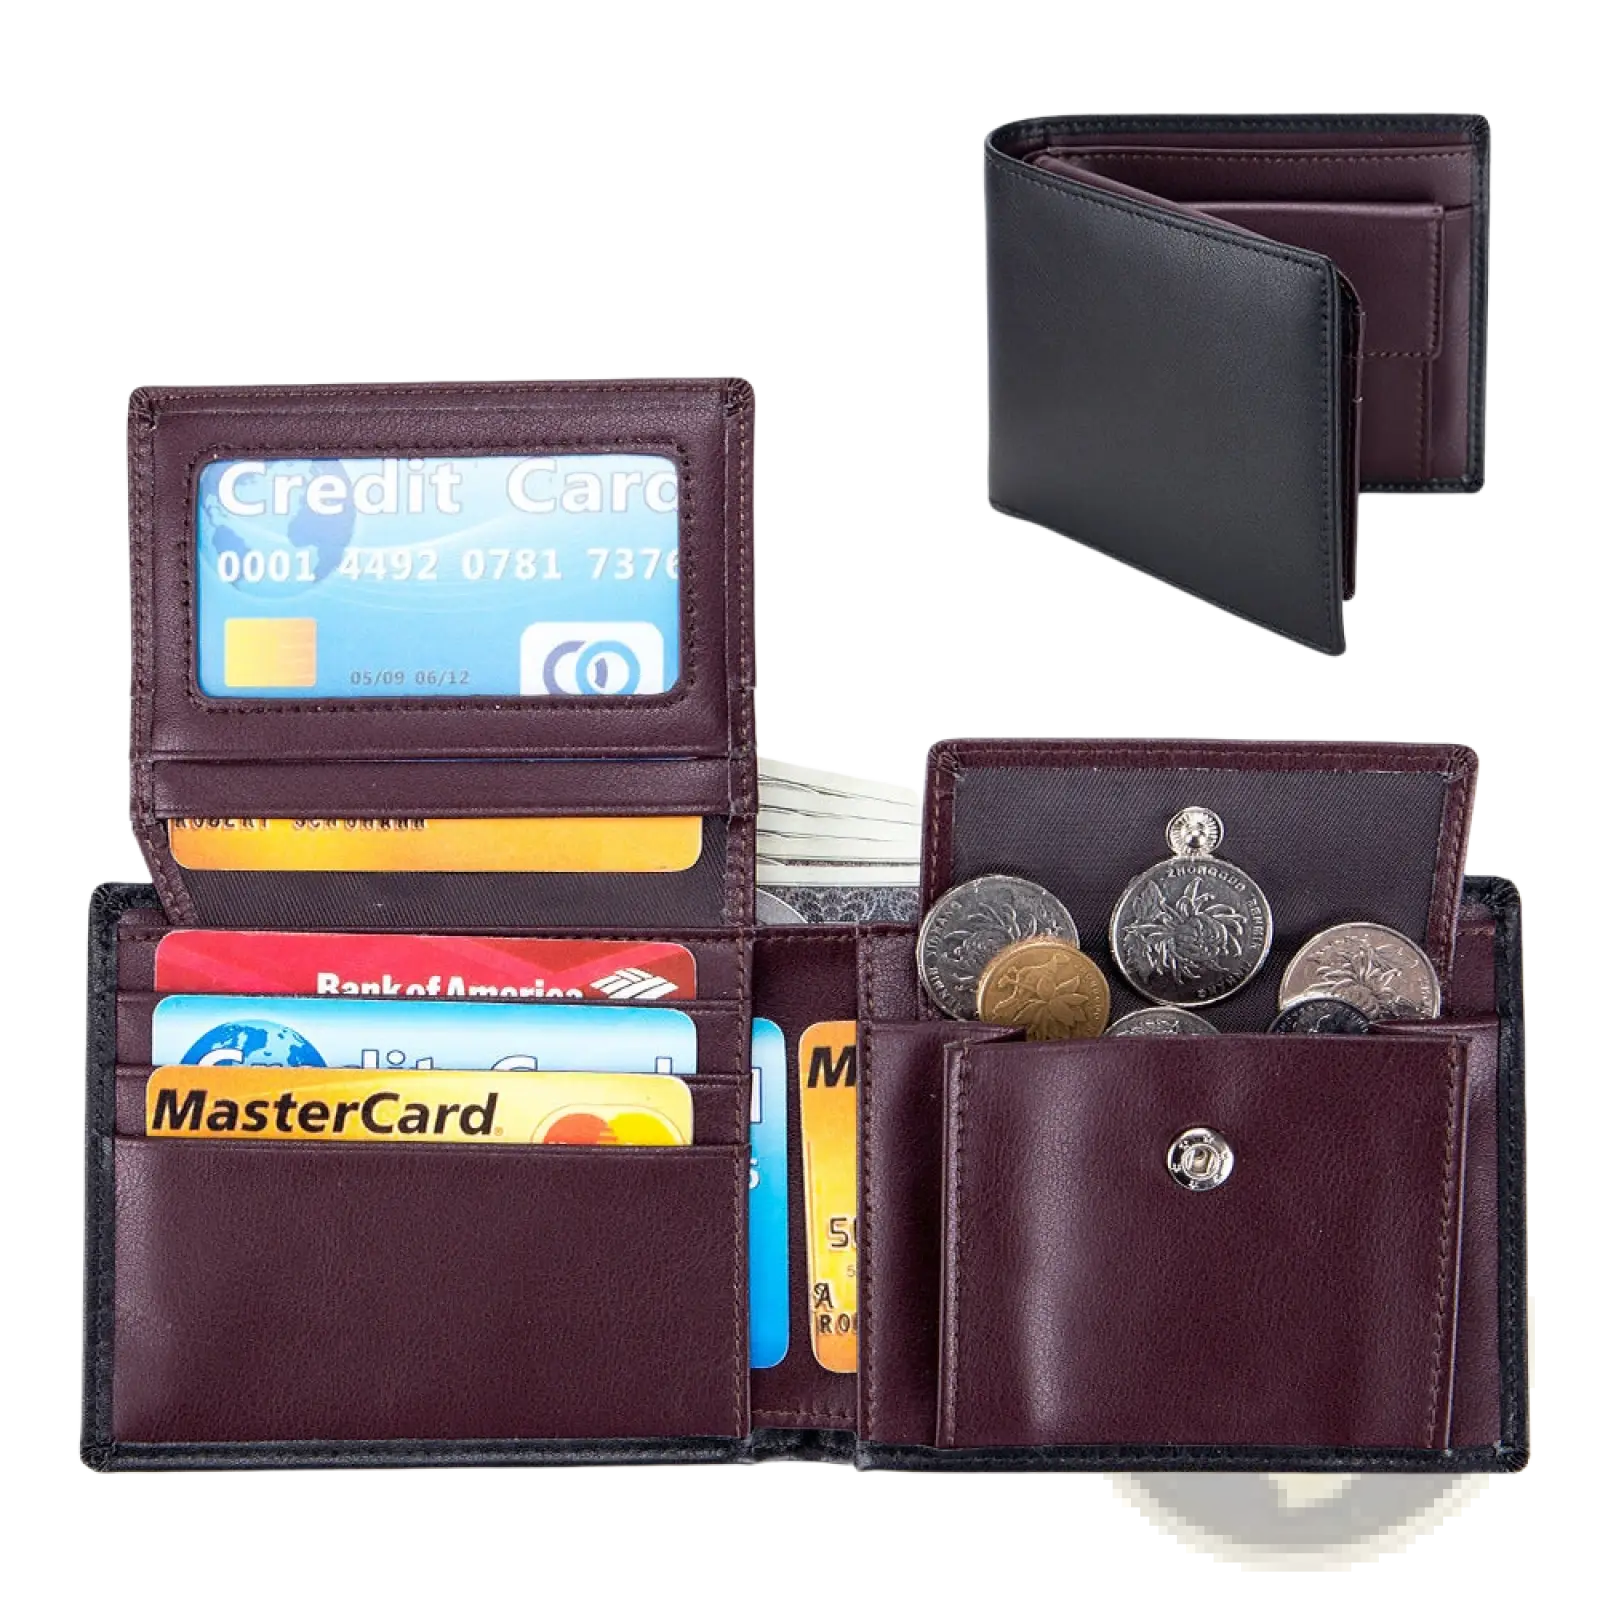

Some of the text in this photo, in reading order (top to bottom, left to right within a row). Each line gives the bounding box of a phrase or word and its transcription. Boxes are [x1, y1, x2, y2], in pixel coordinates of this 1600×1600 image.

[217, 458, 463, 516] Credit
[217, 550, 317, 583] 0001
[337, 548, 440, 582] 4492
[461, 548, 562, 581] 0781
[350, 670, 470, 686] 05/09 06/12
[316, 972, 402, 996] Bank
[406, 975, 441, 997] of
[151, 1088, 499, 1136] MasterCard
